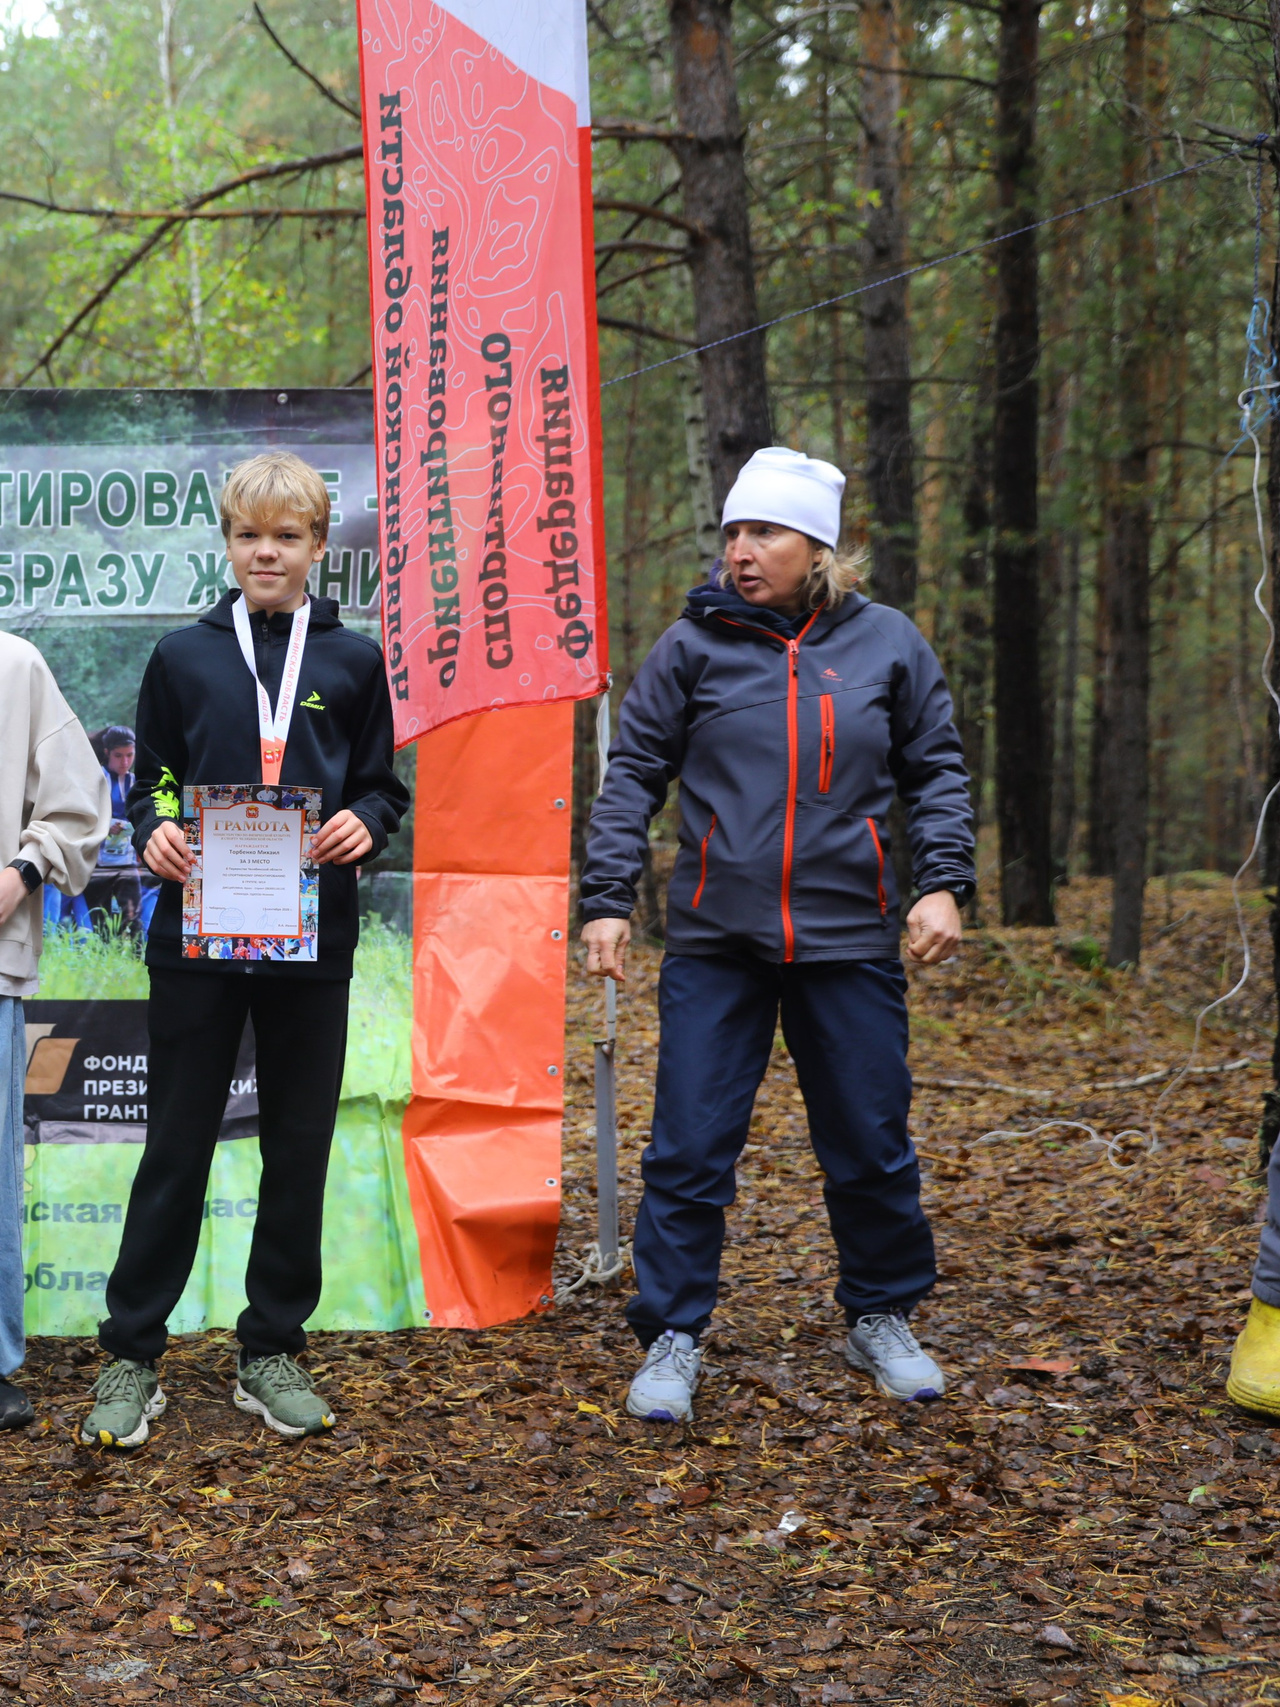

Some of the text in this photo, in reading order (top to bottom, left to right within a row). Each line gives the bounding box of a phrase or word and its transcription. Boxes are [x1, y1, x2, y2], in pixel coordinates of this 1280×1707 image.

[279, 615, 305, 721] ЧЕЛЯБИНСКАЯ ОБЛАСТЬ
[214, 820, 290, 832] ГРАМОТА
[83, 1055, 148, 1074] ФОНД
